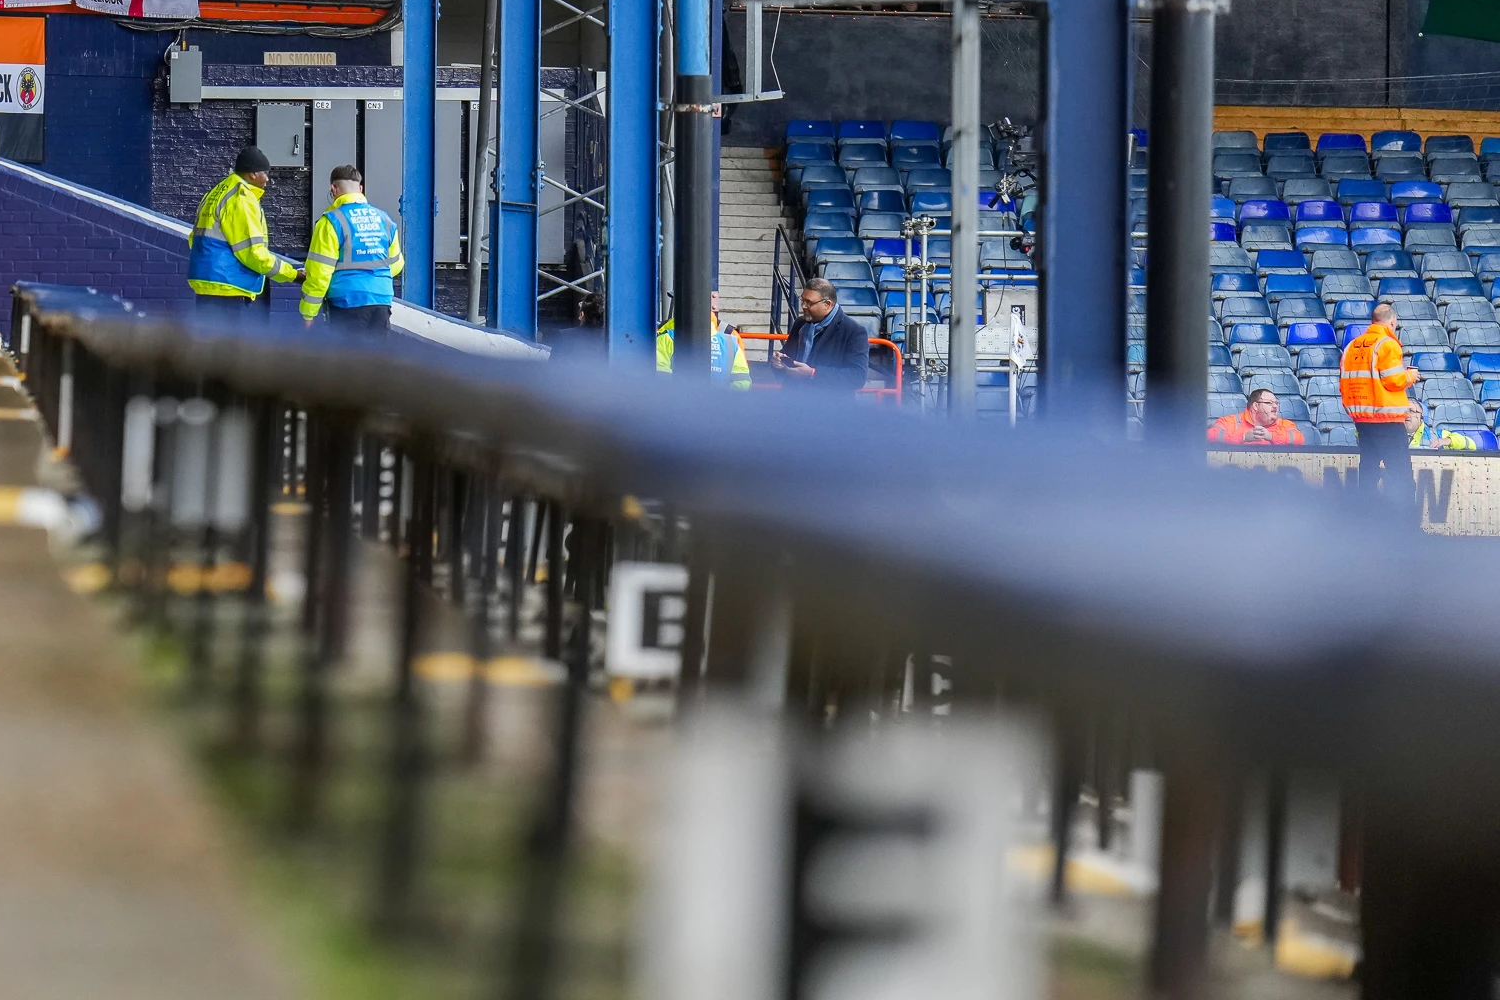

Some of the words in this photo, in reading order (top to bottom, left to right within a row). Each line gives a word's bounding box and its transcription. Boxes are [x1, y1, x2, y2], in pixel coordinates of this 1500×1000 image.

[268, 53, 283, 64] NO
[288, 53, 333, 65] SMOKING
[315, 102, 330, 110] CE2
[367, 102, 381, 110] CN3
